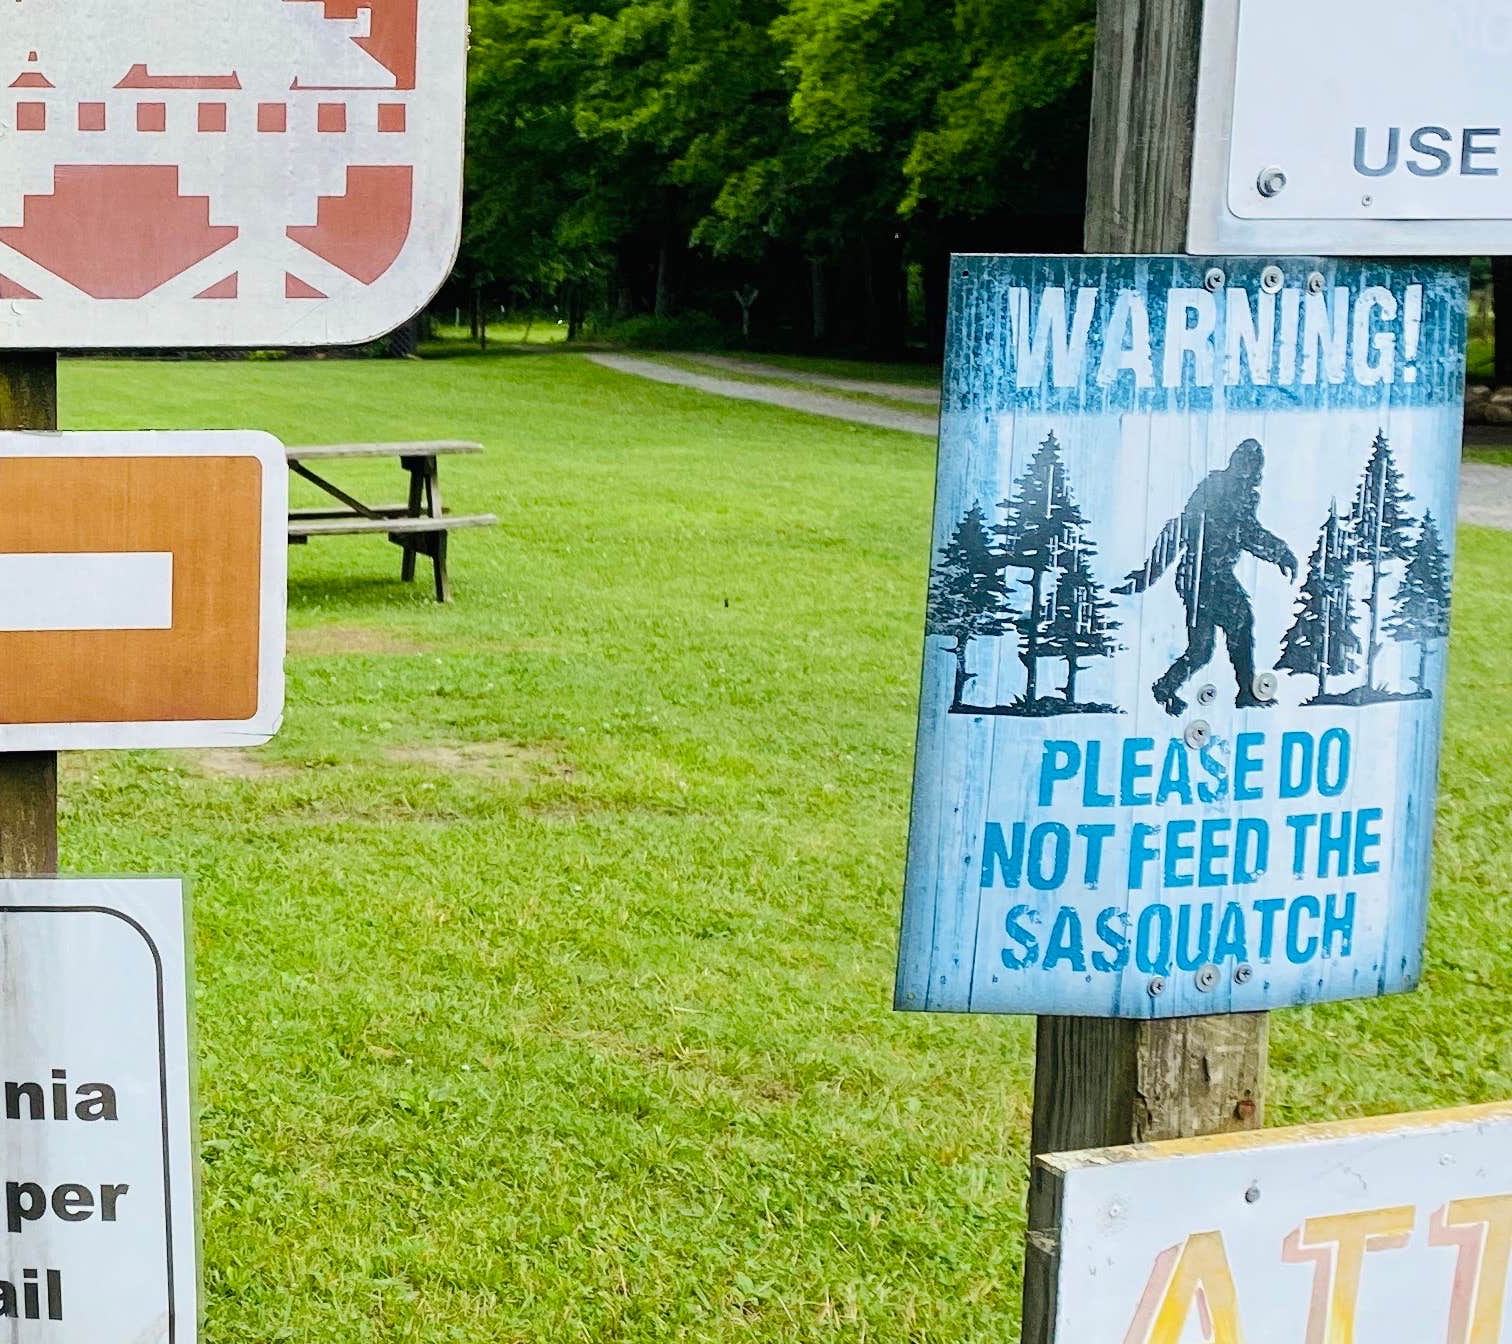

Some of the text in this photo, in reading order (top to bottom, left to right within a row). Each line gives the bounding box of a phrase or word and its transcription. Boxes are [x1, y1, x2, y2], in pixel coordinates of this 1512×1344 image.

[1352, 126, 1501, 178] USE
[1008, 283, 1423, 389] WARNING!
[1037, 727, 1352, 809] PLEASE DO
[980, 807, 1383, 890] NOT FEED THE
[1001, 891, 1356, 975] SASQUATCH
